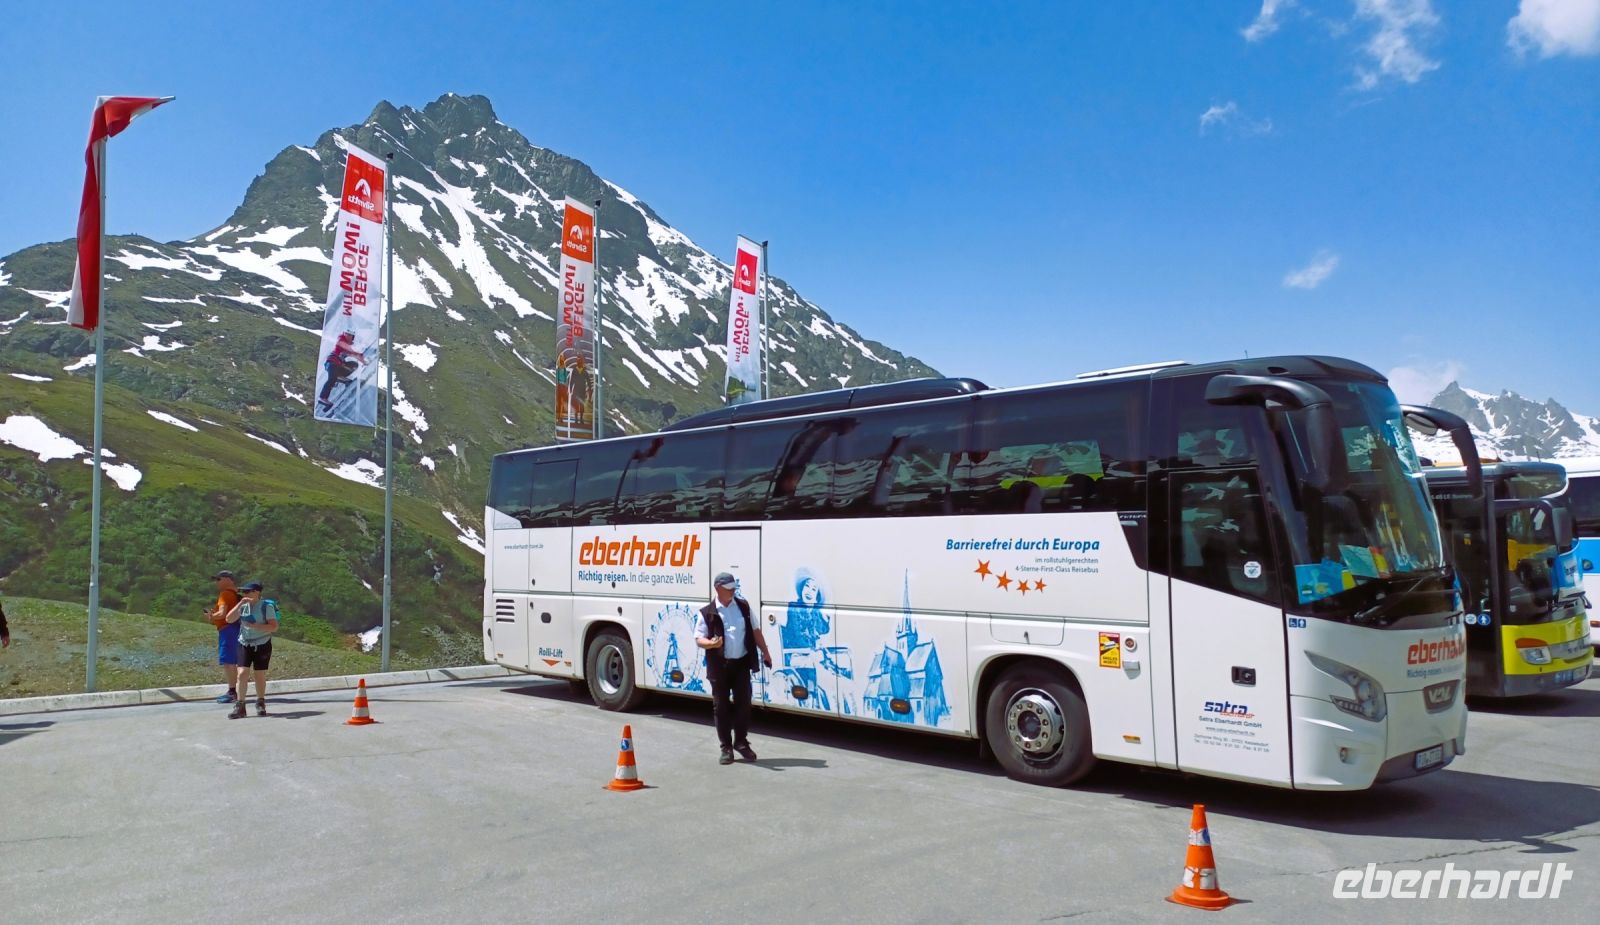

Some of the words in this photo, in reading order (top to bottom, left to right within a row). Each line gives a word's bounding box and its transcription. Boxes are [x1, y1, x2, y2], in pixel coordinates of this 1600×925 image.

[579, 535, 701, 567] eberhardt
[946, 538, 1013, 550] Barrierefrei
[1015, 538, 1049, 551] durch
[1052, 538, 1100, 554] Europa
[1043, 557, 1099, 565] rollstuhlgerechten
[578, 570, 603, 584] Richtig
[603, 571, 629, 583] reisen.
[630, 573, 637, 583] In
[639, 572, 650, 583] die
[651, 575, 674, 586] ganze
[675, 573, 696, 584] Welt.
[538, 647, 563, 658] Rolli-Lift
[1204, 701, 1248, 715] satra
[1214, 718, 1243, 727] Eberhardt
[1243, 721, 1263, 729] GmbH
